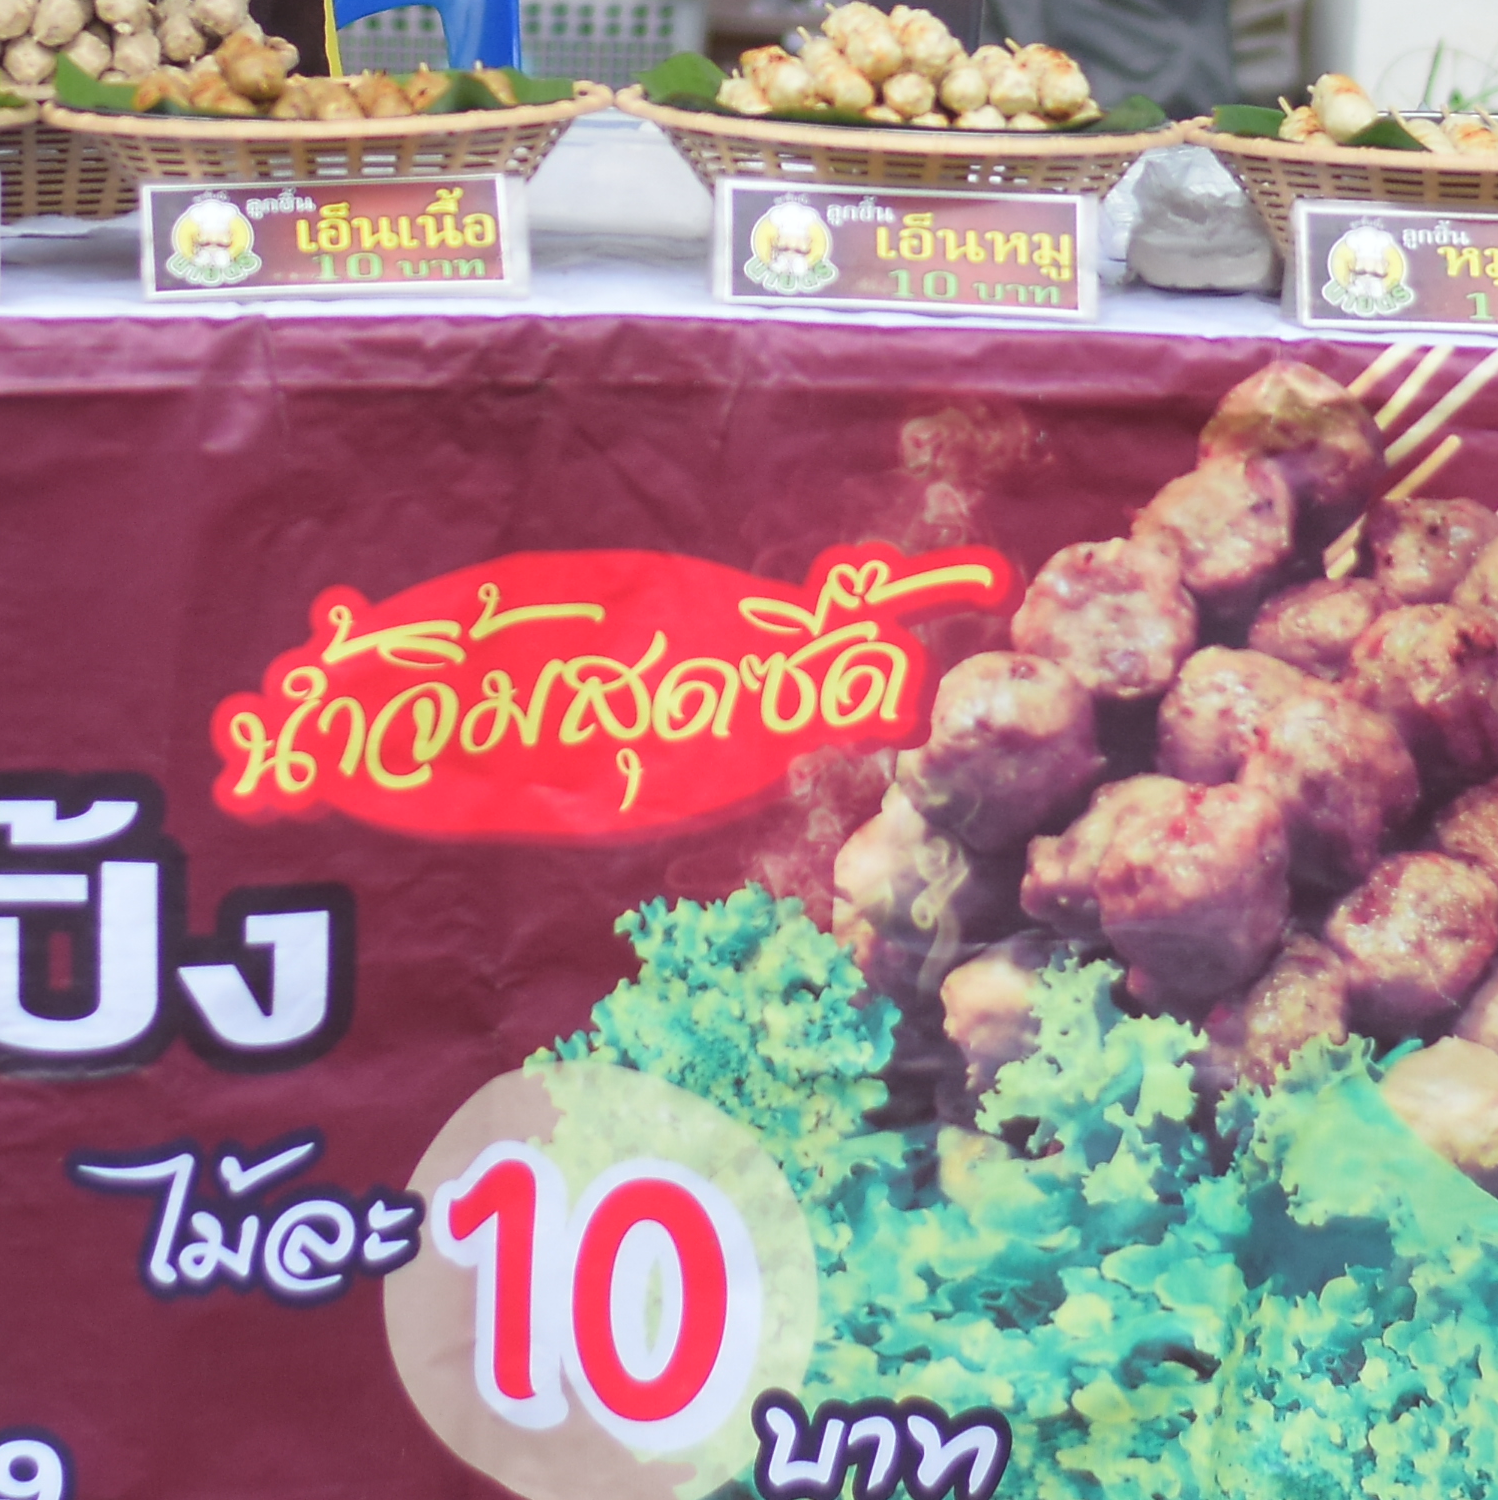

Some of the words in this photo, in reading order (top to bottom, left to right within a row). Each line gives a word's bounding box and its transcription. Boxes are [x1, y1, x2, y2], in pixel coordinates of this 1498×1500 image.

[296, 187, 496, 253] เอ็นเนื้อ
[876, 212, 1072, 281] เอ็นหมู
[312, 252, 383, 280] 10
[397, 257, 486, 279] บาท
[888, 269, 959, 300] 10
[973, 281, 1061, 305] บาท
[78, 1142, 414, 1291] ไม้ละ
[448, 1156, 728, 1422] 10
[765, 1406, 998, 1495] บาท
